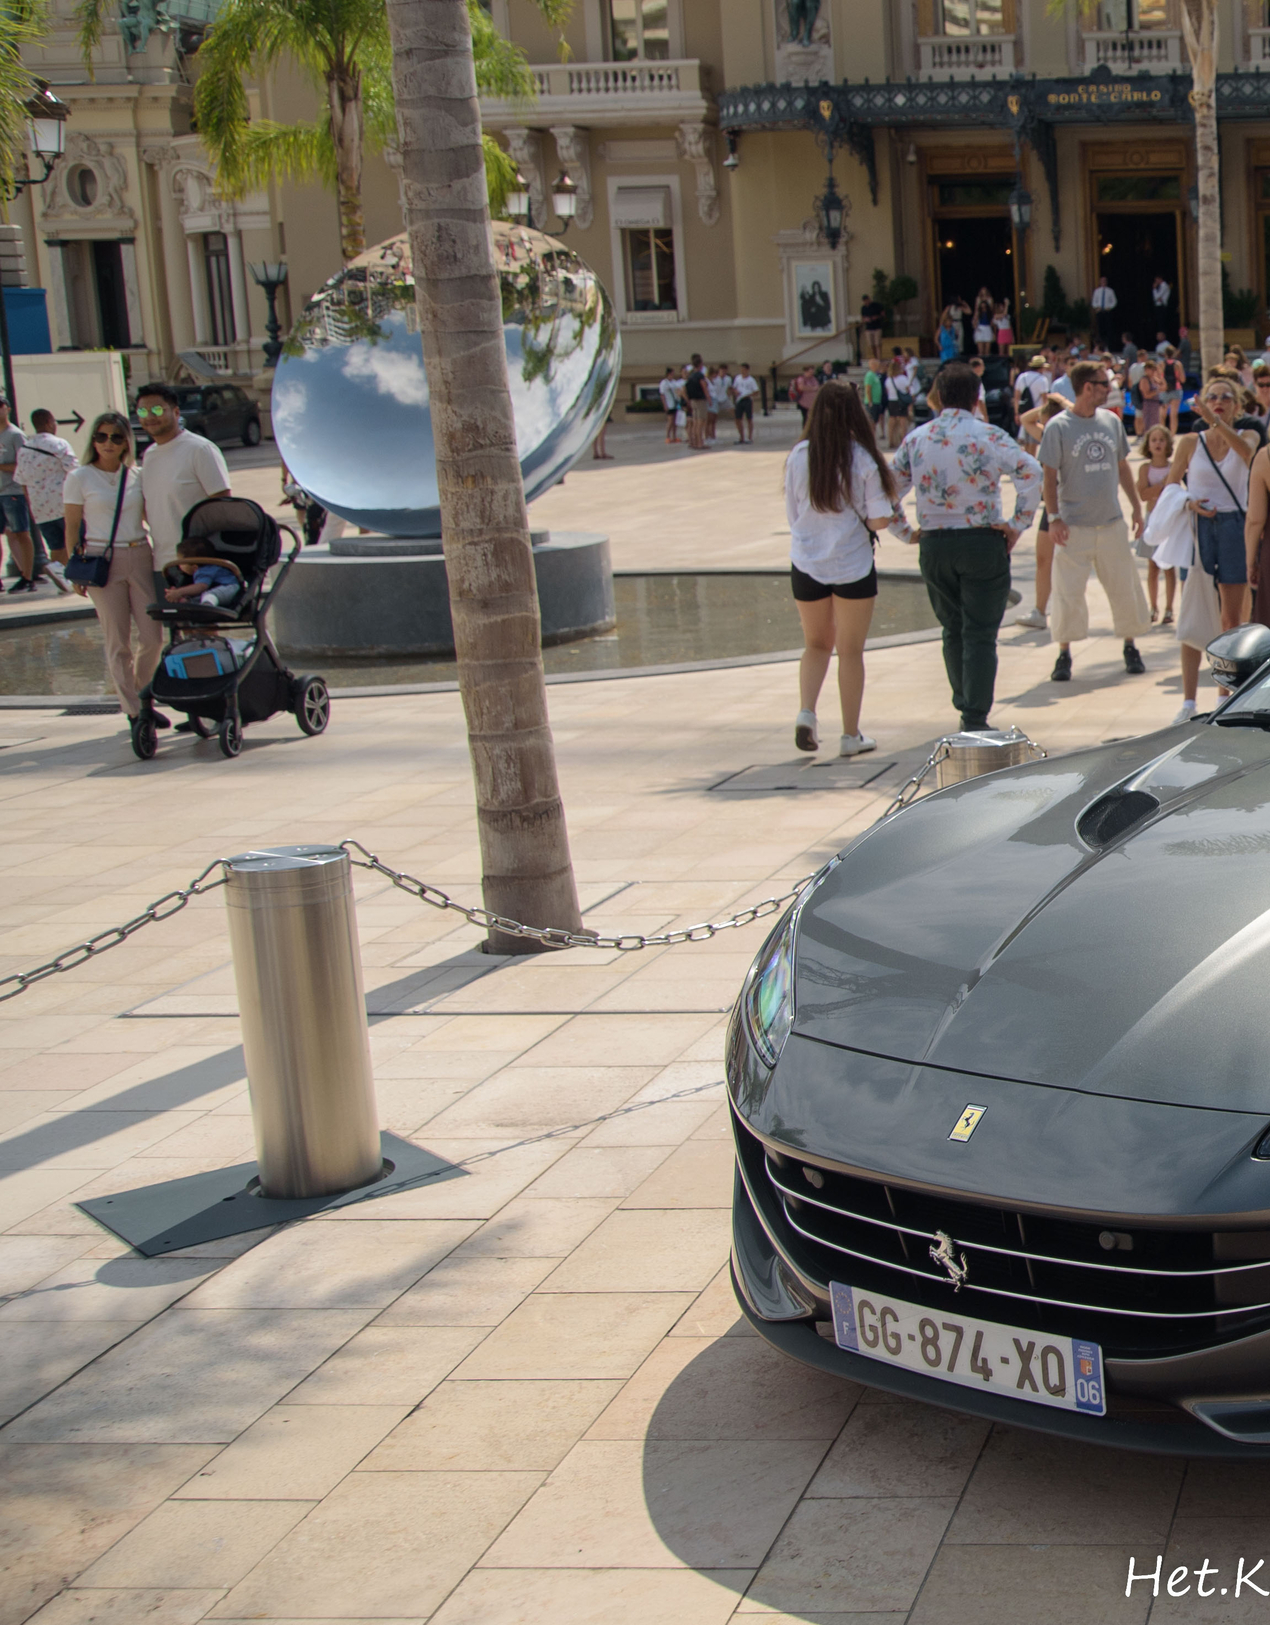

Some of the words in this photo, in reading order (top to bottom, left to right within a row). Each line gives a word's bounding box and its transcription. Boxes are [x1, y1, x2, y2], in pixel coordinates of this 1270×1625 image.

[1078, 84, 1131, 93] CASINO
[842, 1321, 849, 1336] F
[857, 1299, 1066, 1399] GG-874-XQ
[1076, 1378, 1101, 1405] 06
